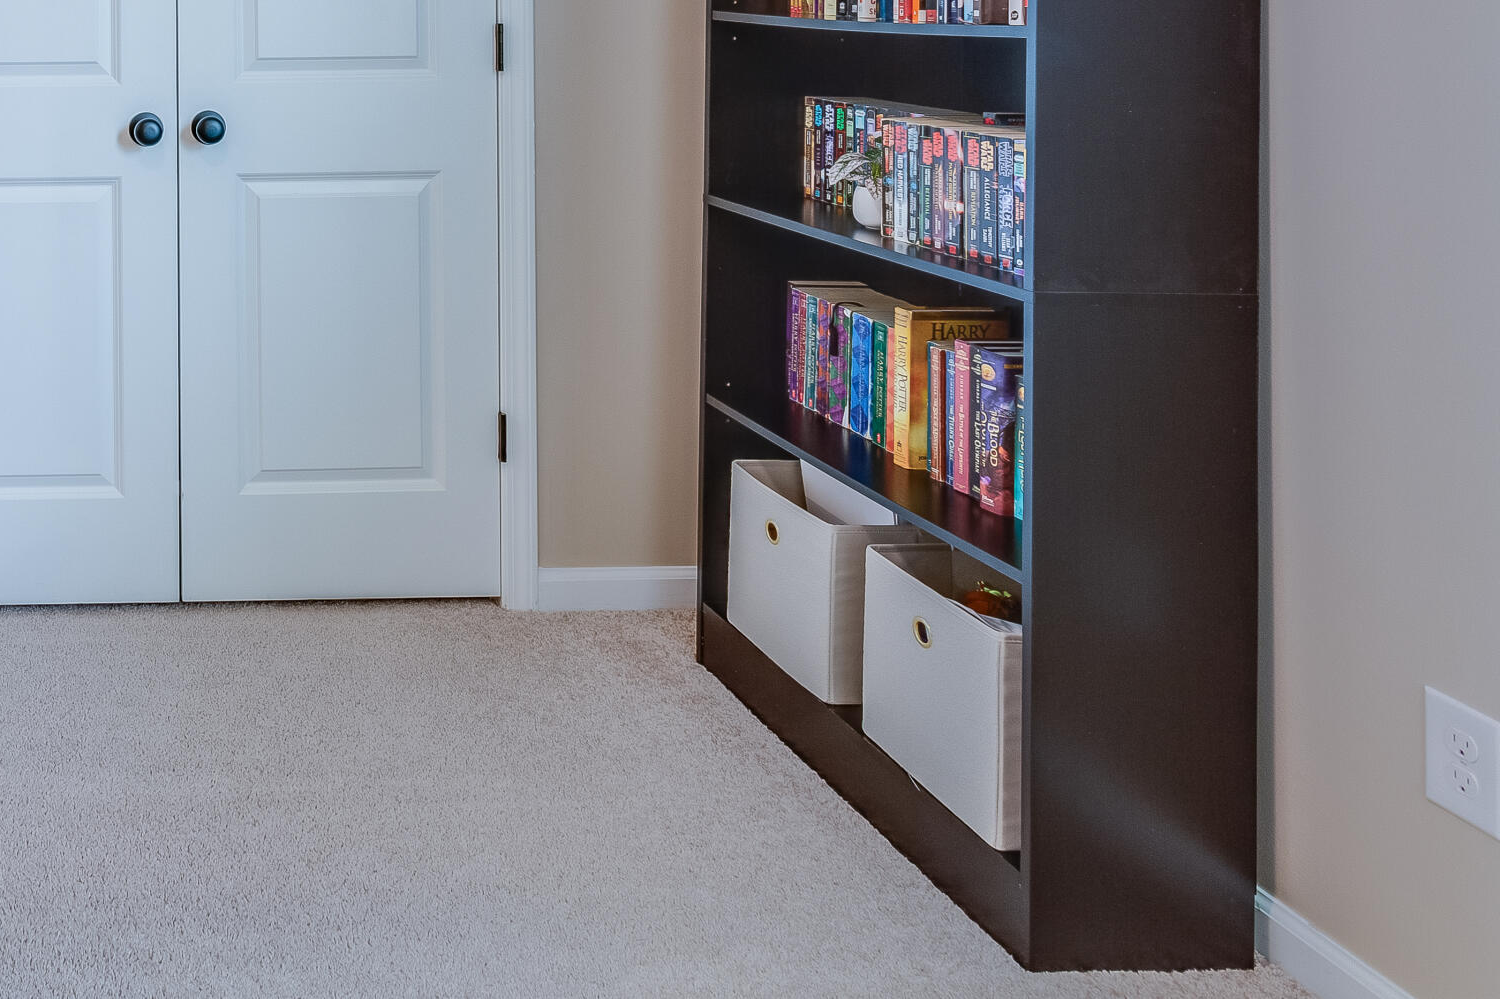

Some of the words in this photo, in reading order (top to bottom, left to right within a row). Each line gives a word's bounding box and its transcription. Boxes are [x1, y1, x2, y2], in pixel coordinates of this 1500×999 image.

[980, 140, 989, 171] WARS
[998, 142, 1008, 177] WARS
[1006, 147, 1014, 177] STAR
[1002, 188, 1014, 228] FORCE
[930, 322, 991, 341] HARRY
[898, 335, 908, 371] HARRY
[898, 372, 908, 413] POTTER
[987, 422, 999, 467] BLOOD
